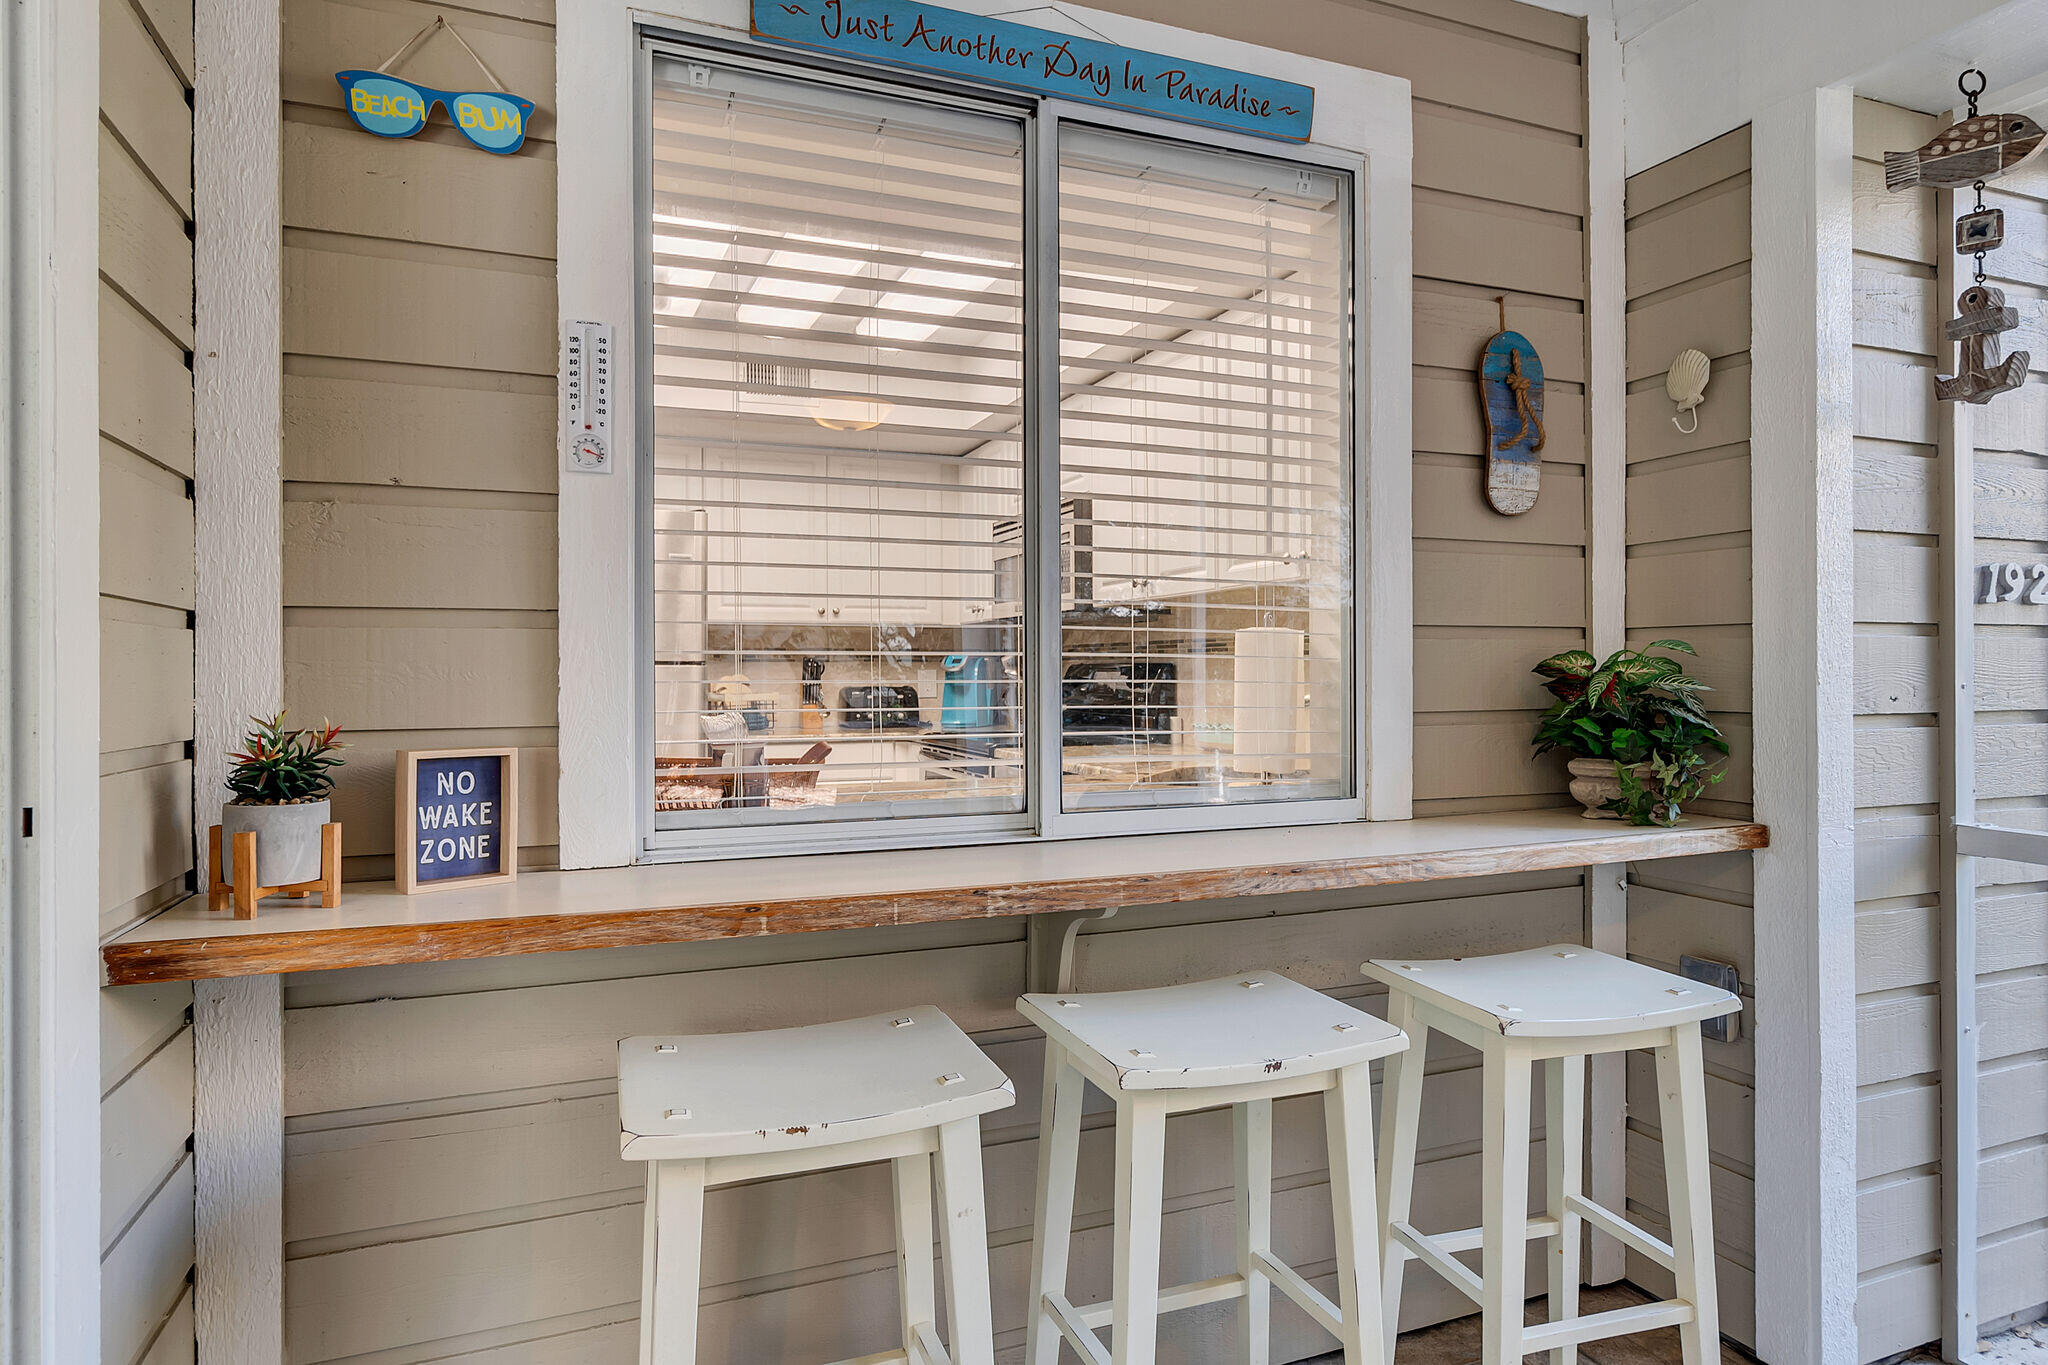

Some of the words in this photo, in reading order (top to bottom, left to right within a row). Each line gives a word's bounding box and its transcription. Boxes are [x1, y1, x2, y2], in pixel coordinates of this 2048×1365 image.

[821, 0, 894, 41] Just
[902, 14, 1033, 68] Another
[1043, 41, 1111, 97] Day
[1124, 59, 1147, 93] In
[1155, 70, 1271, 117] Paradise
[351, 88, 425, 121] BEACH
[458, 102, 521, 135] BUM
[1985, 562, 2048, 604] 192
[437, 770, 476, 796] NO
[418, 801, 493, 830] WAKE
[420, 834, 490, 864] ZONE
